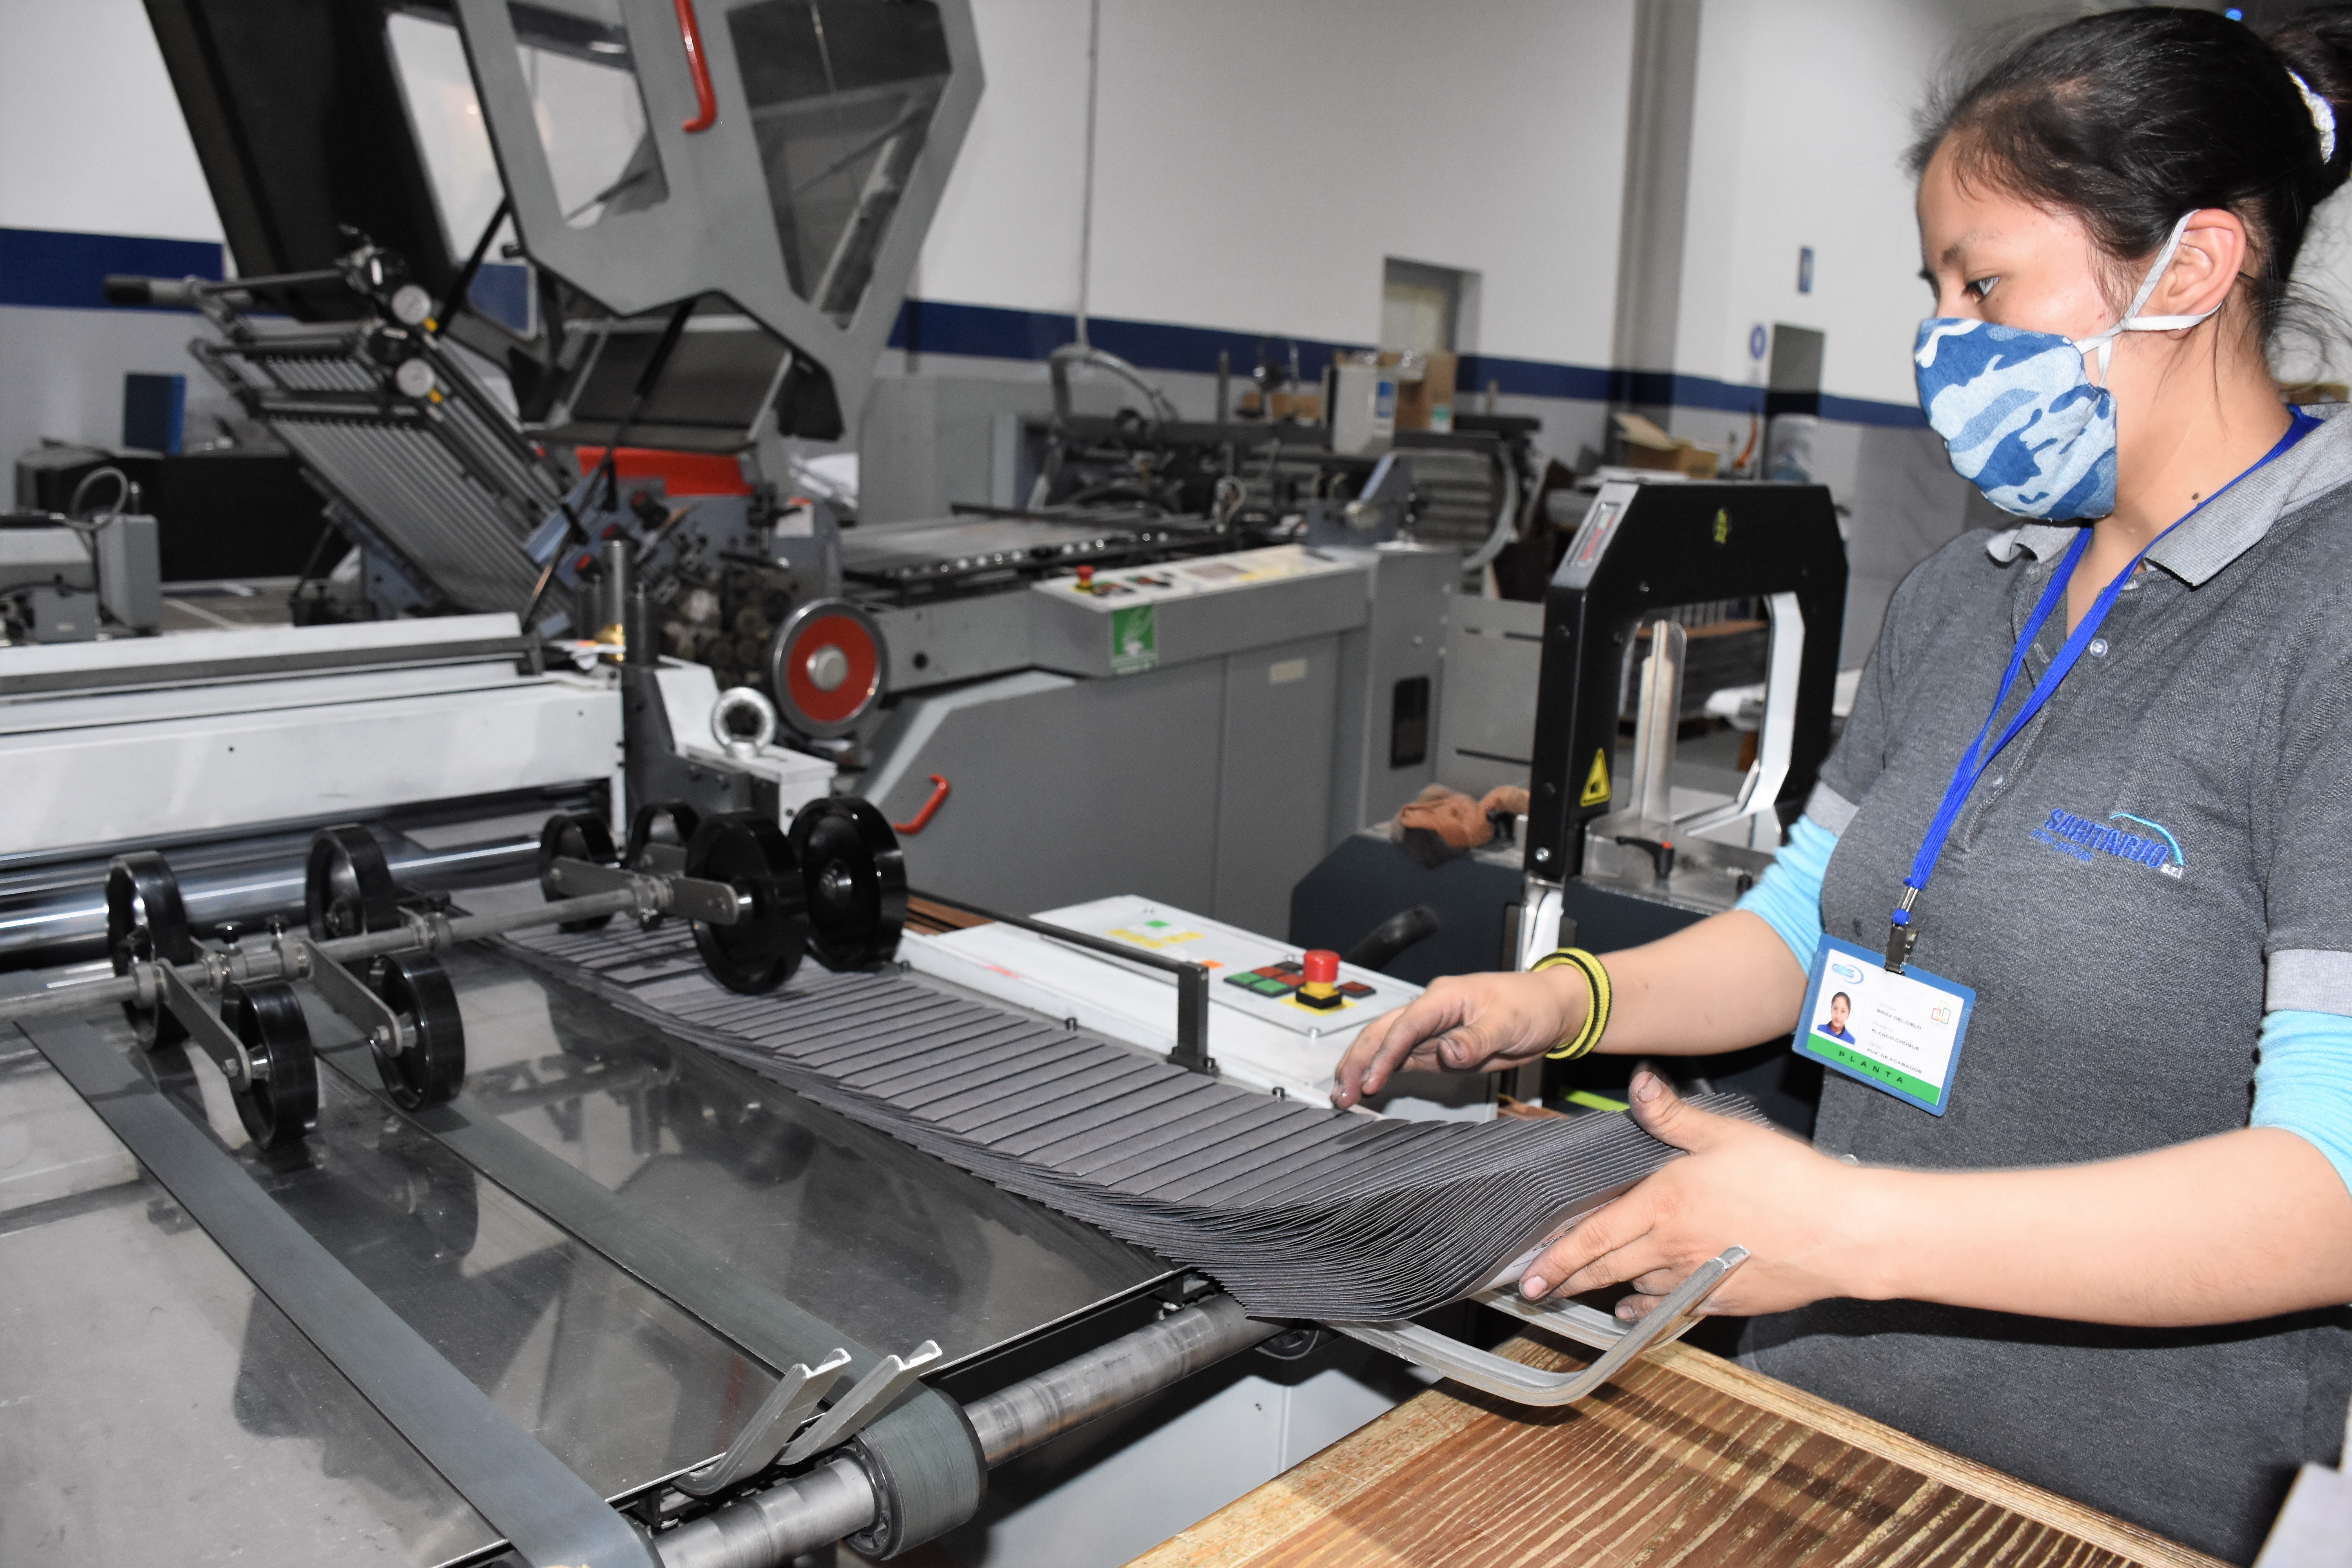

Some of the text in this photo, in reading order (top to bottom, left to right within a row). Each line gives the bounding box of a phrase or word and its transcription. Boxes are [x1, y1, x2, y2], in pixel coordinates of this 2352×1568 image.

[2045, 808, 2169, 868] SAGITARIO
[1905, 1020, 1922, 1030] CIELO
[1872, 1028, 1920, 1051] BLANCO CHOQUE
[1839, 1051, 1902, 1083] PLANTA
[1889, 1058, 1922, 1074] ACABADOS
